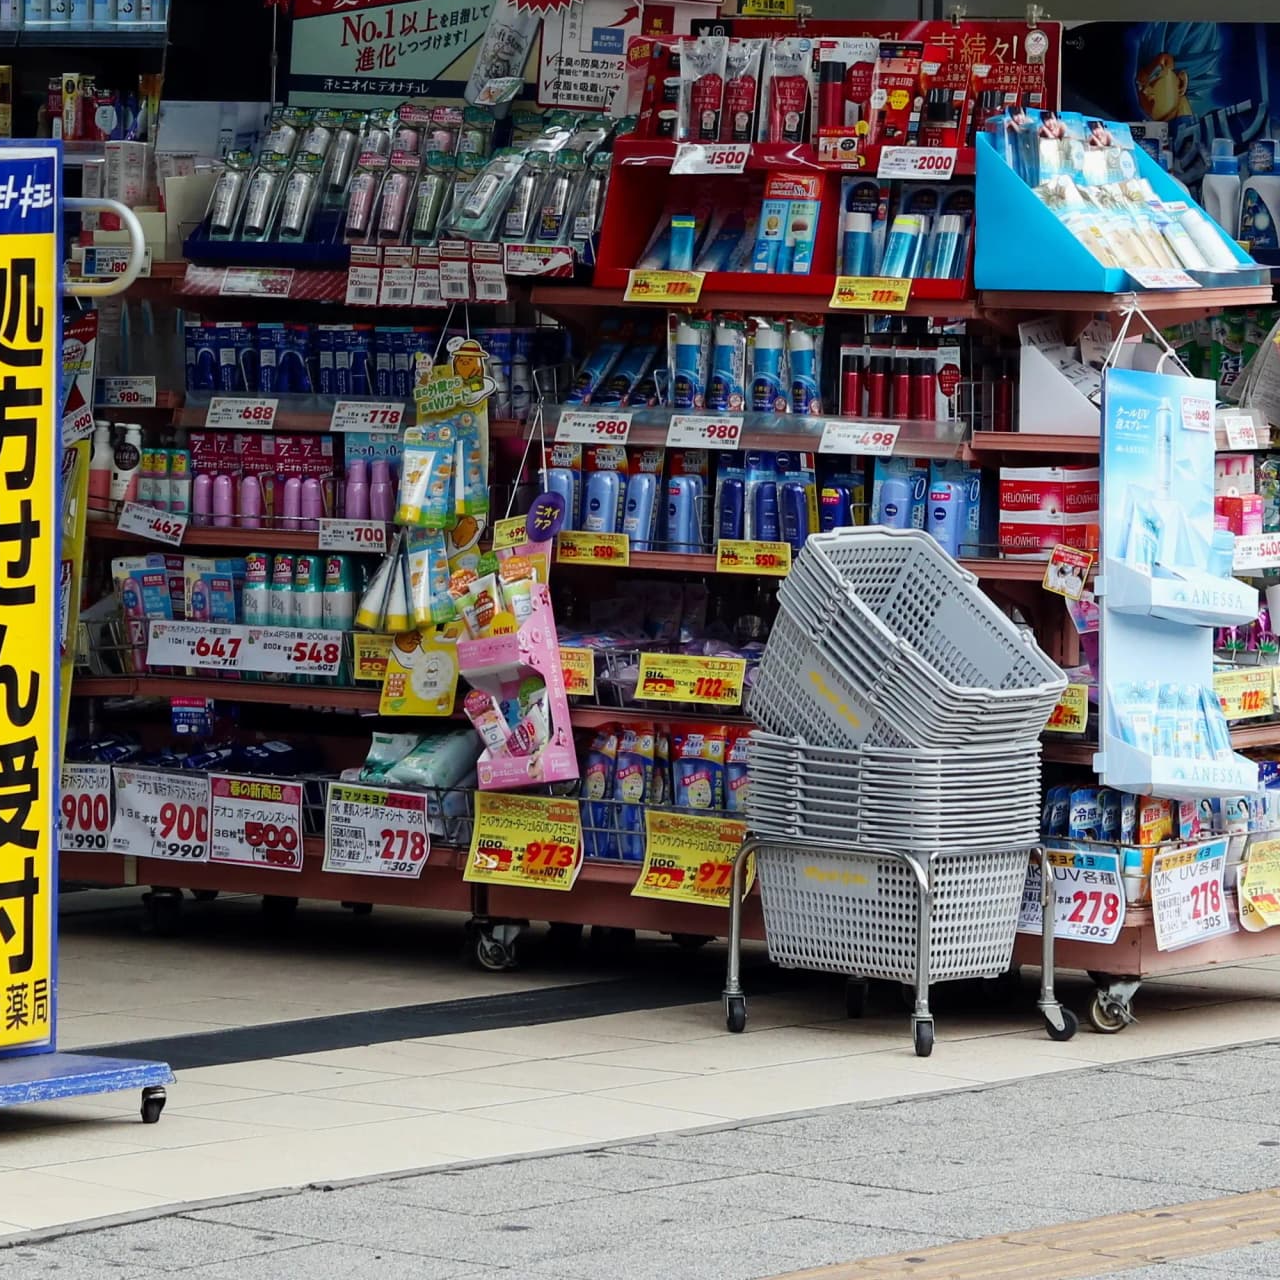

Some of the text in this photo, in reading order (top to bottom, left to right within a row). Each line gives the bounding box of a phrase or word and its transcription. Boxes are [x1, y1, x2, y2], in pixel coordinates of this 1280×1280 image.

[243, 406, 273, 420] 688
[368, 410, 402, 425] 778
[595, 420, 628, 436] 980
[705, 424, 738, 440] 980
[151, 519, 182, 535] 462
[353, 527, 384, 542] 700
[1192, 590, 1244, 610] ANESSA
[493, 626, 514, 636] NEW!
[195, 637, 242, 658] 647
[293, 642, 339, 663] 548
[230, 780, 282, 800] 春の新商品
[62, 793, 108, 831] 900
[160, 802, 208, 842] 900
[75, 835, 106, 848] 990
[380, 829, 426, 862] 278
[168, 842, 204, 858] 990
[526, 842, 575, 868] 973
[391, 861, 416, 872] 305
[699, 862, 732, 886] 97
[1190, 879, 1221, 919] 278
[1068, 890, 1119, 925] 278
[1203, 915, 1221, 930] 305
[1080, 925, 1109, 937] 305
